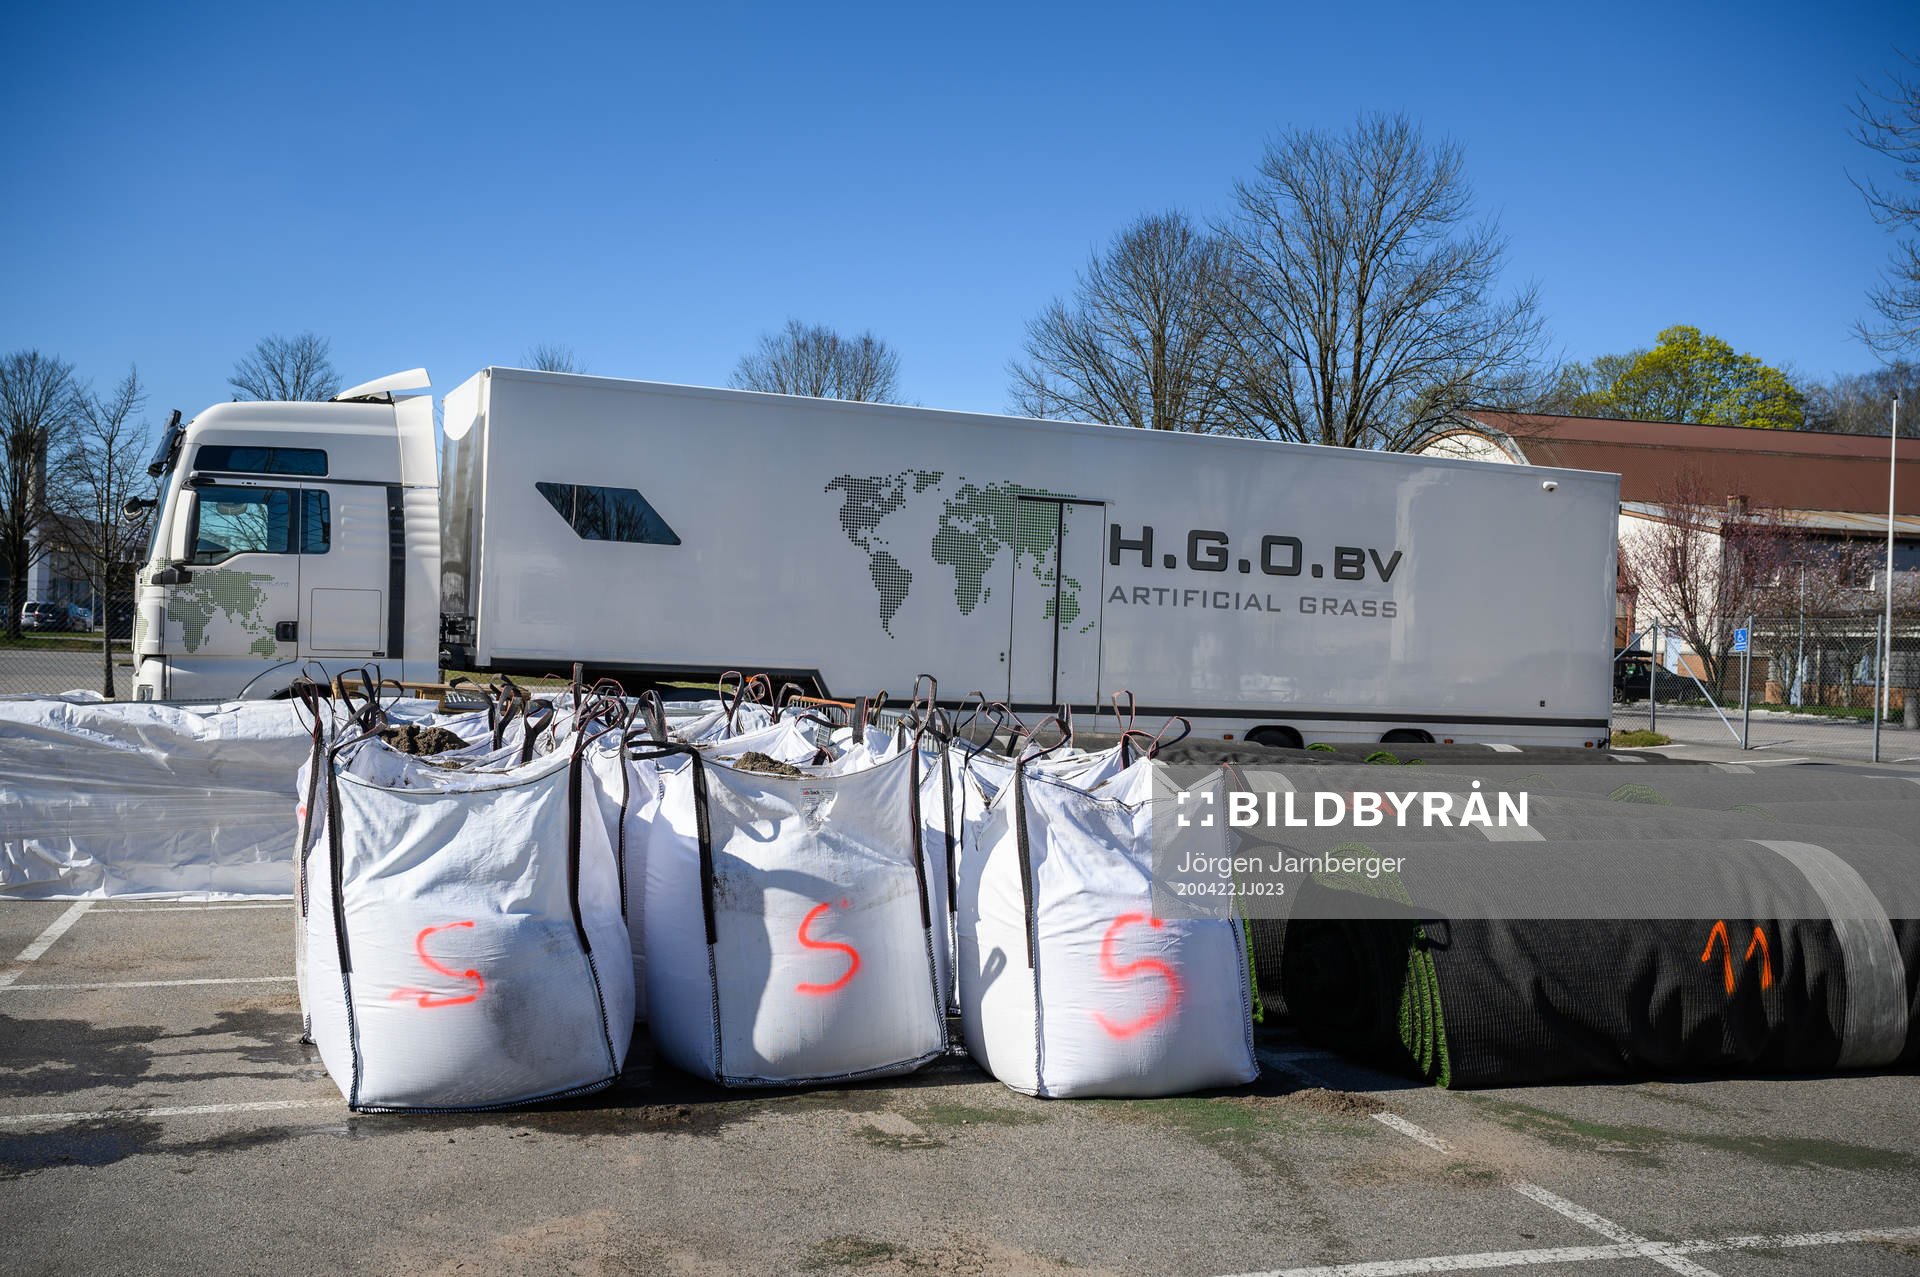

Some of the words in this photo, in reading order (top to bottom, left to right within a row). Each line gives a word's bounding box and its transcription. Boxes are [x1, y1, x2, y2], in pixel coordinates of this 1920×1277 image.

[1108, 585, 1281, 613] ARTIFICIAL
[1300, 596, 1398, 618] GRASS
[795, 899, 861, 997] S
[1096, 911, 1182, 1041] S
